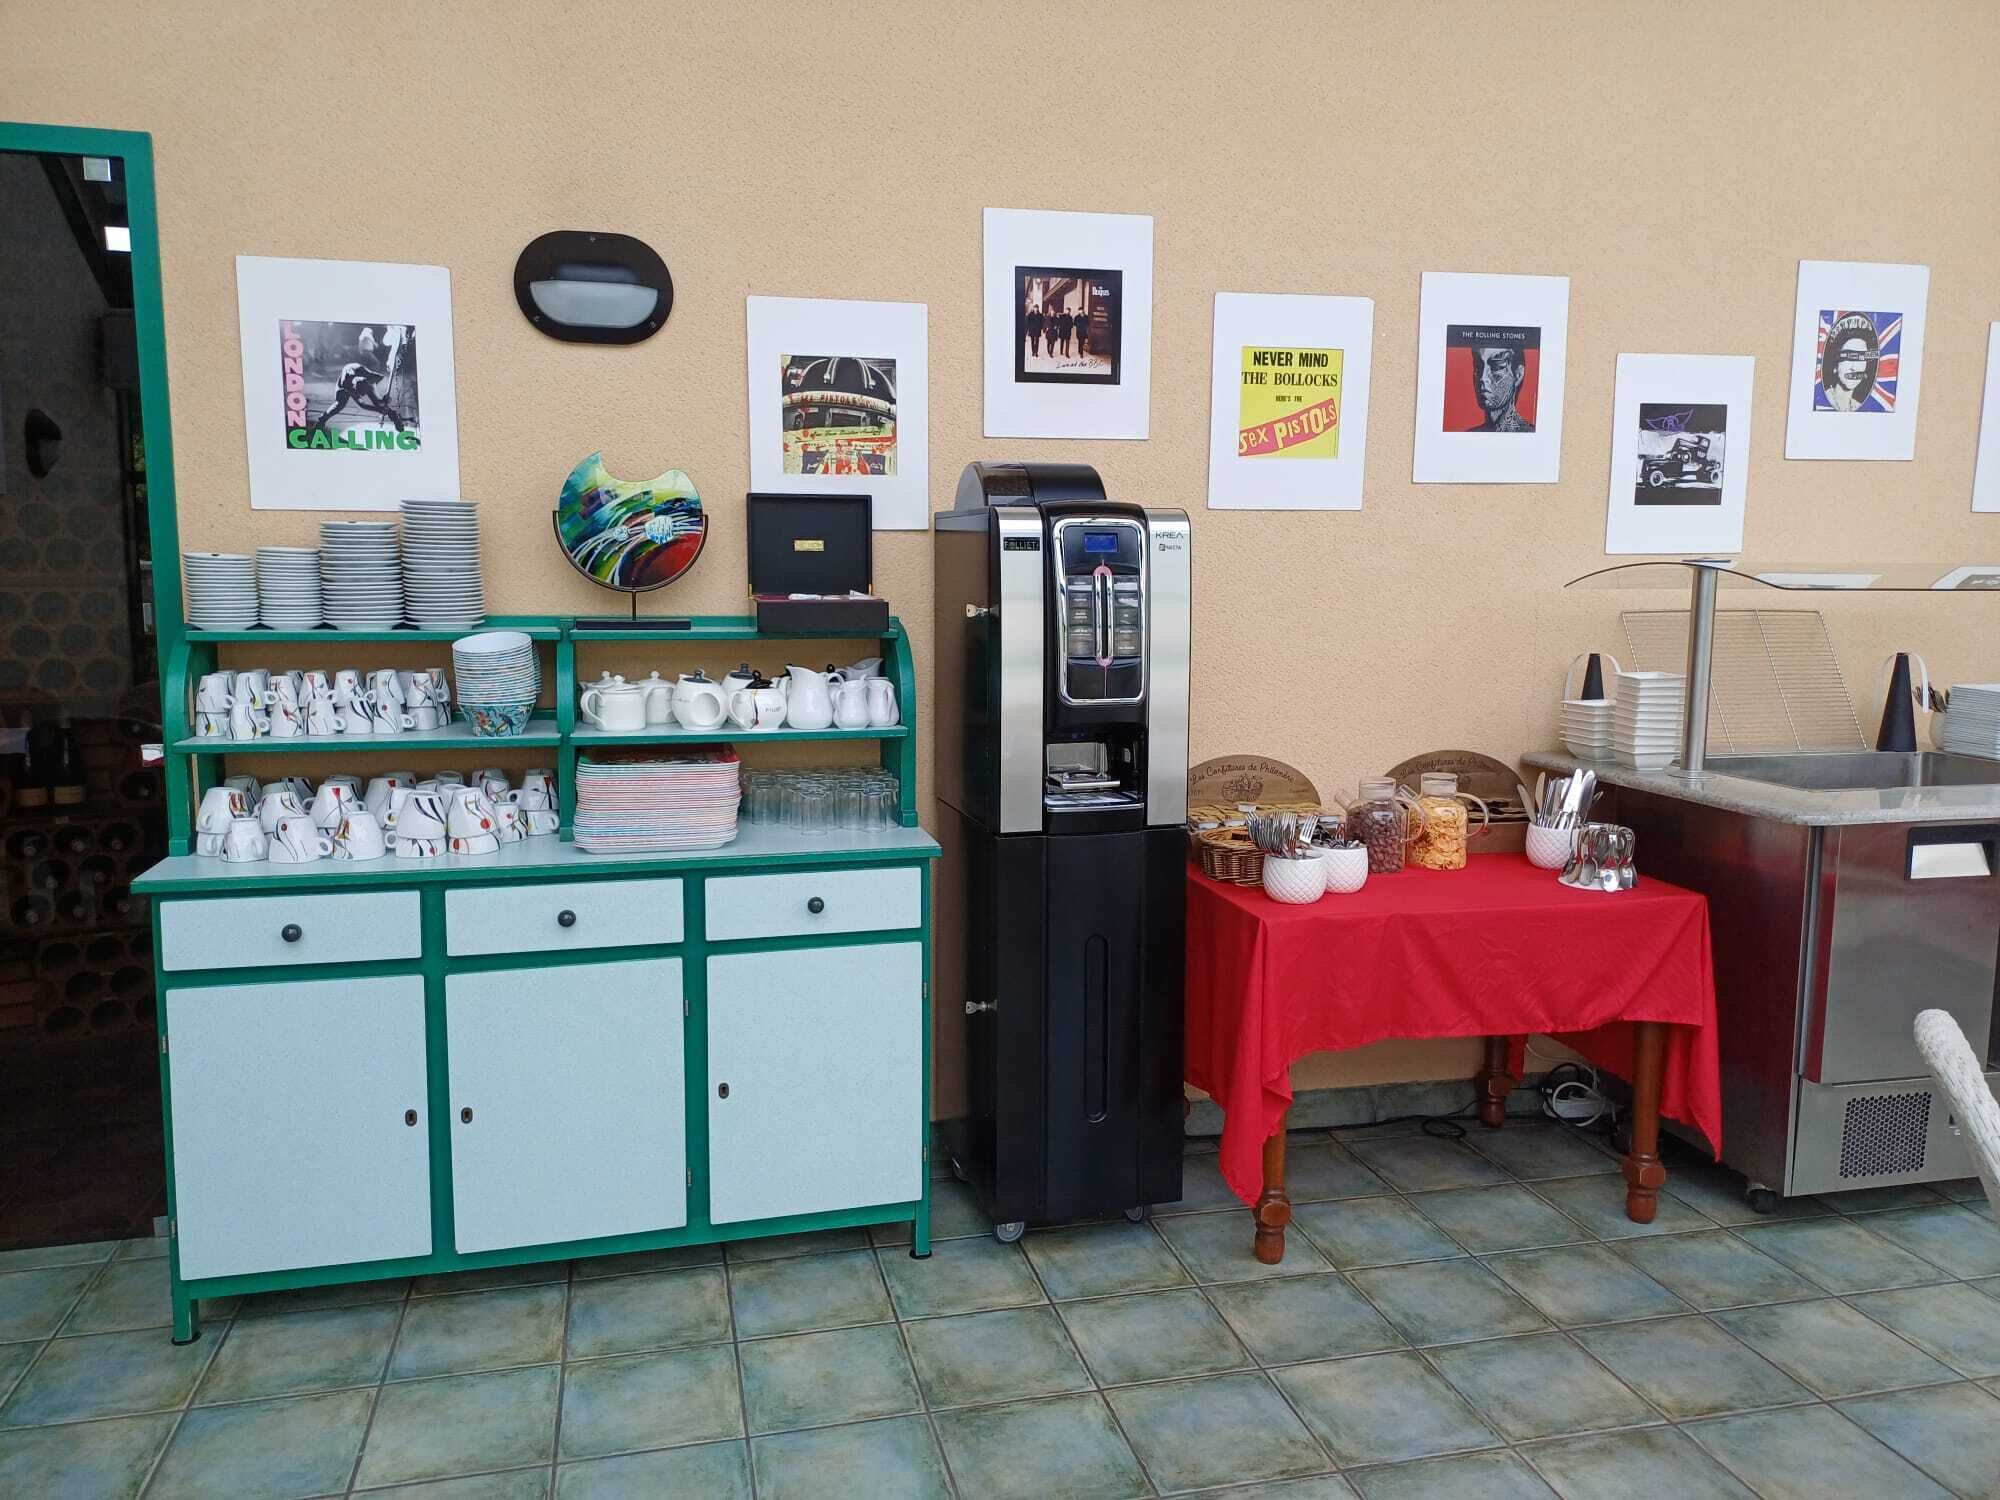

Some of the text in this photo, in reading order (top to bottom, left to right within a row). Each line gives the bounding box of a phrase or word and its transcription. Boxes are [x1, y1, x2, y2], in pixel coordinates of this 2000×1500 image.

[1475, 331, 1500, 339] ROLLING
[1502, 332, 1524, 340] STONES
[1253, 351, 1329, 368] NEVER MIND
[283, 320, 307, 427] LONDON
[1242, 371, 1338, 387] THE BOLLOCKS
[289, 429, 417, 450] CALLING
[1155, 531, 1184, 539] KREA
